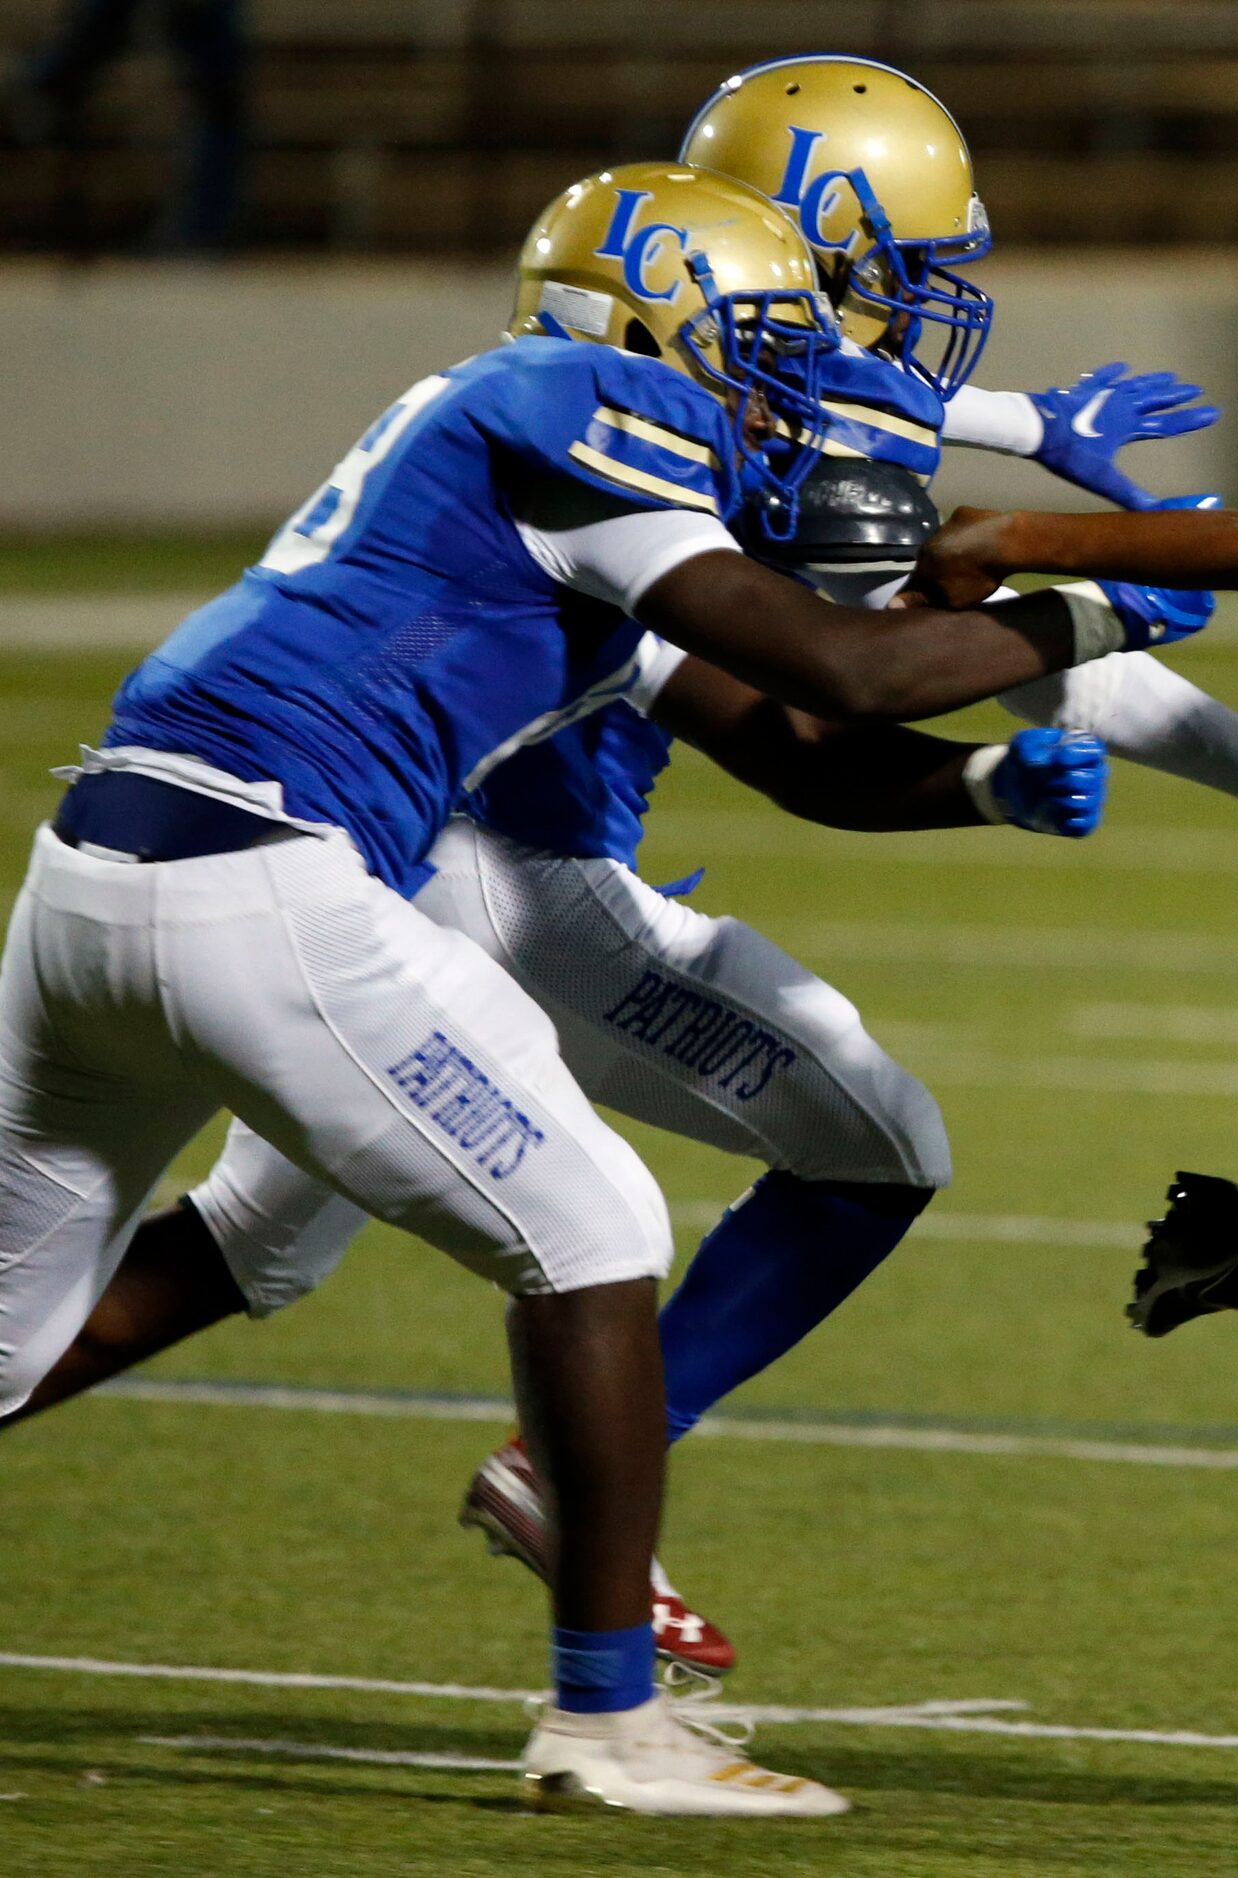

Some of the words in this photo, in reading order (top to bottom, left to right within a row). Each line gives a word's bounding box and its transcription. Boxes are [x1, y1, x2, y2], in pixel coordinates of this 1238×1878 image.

[594, 188, 692, 305] LC
[768, 125, 860, 255] LC
[603, 970, 796, 1099] PATRIOTS
[387, 1031, 545, 1180] PATRIOTS
